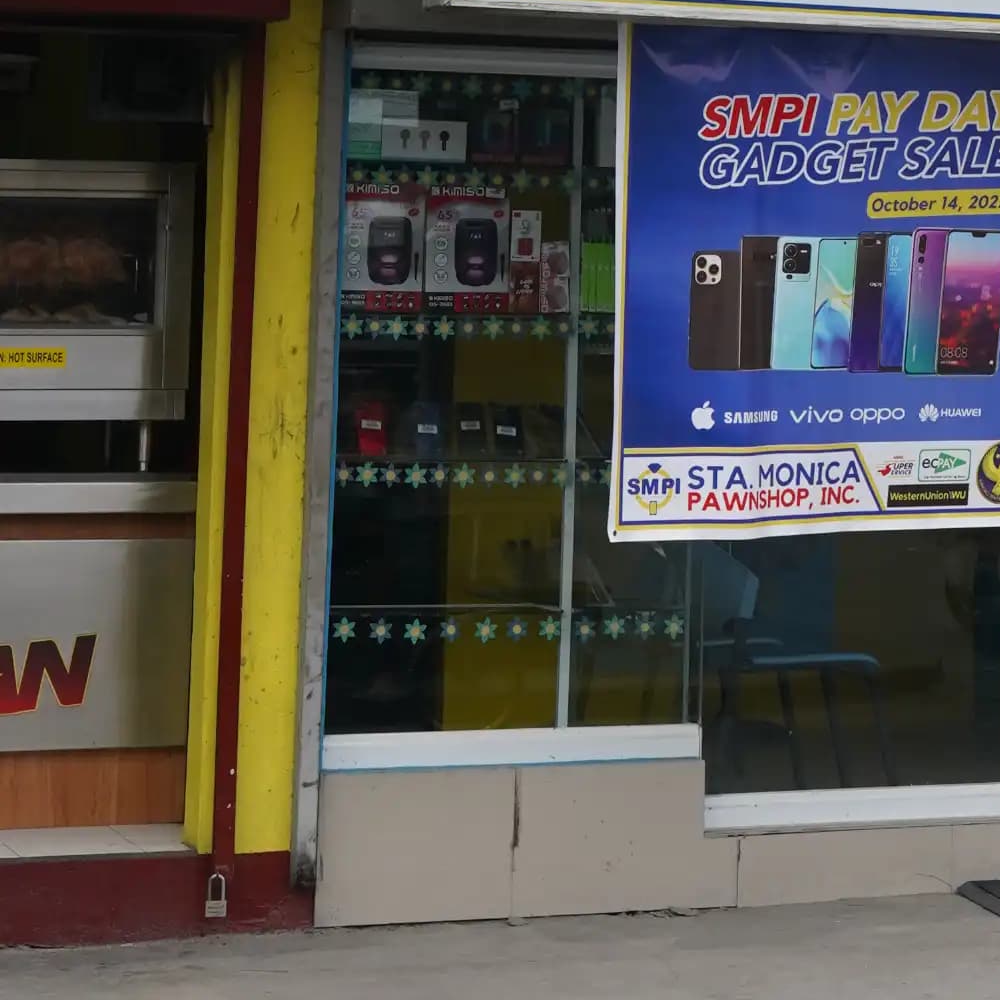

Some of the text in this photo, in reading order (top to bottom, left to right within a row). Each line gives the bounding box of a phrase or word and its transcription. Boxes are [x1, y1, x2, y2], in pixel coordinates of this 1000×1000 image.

[698, 92, 818, 140] SMPI
[826, 90, 918, 136] PAY
[699, 137, 896, 189] GADGET
[871, 196, 938, 214] October
[942, 195, 964, 213] 14,
[8, 352, 25, 363] HOT
[26, 352, 63, 363] SURFACE
[723, 409, 778, 425] SAMSUNG
[789, 405, 844, 425] vivo
[940, 408, 982, 418] HUAWEI
[627, 477, 681, 497] SMPI
[688, 460, 861, 491] STA. MONICA
[687, 484, 860, 512] PAWNSHOP, INC.
